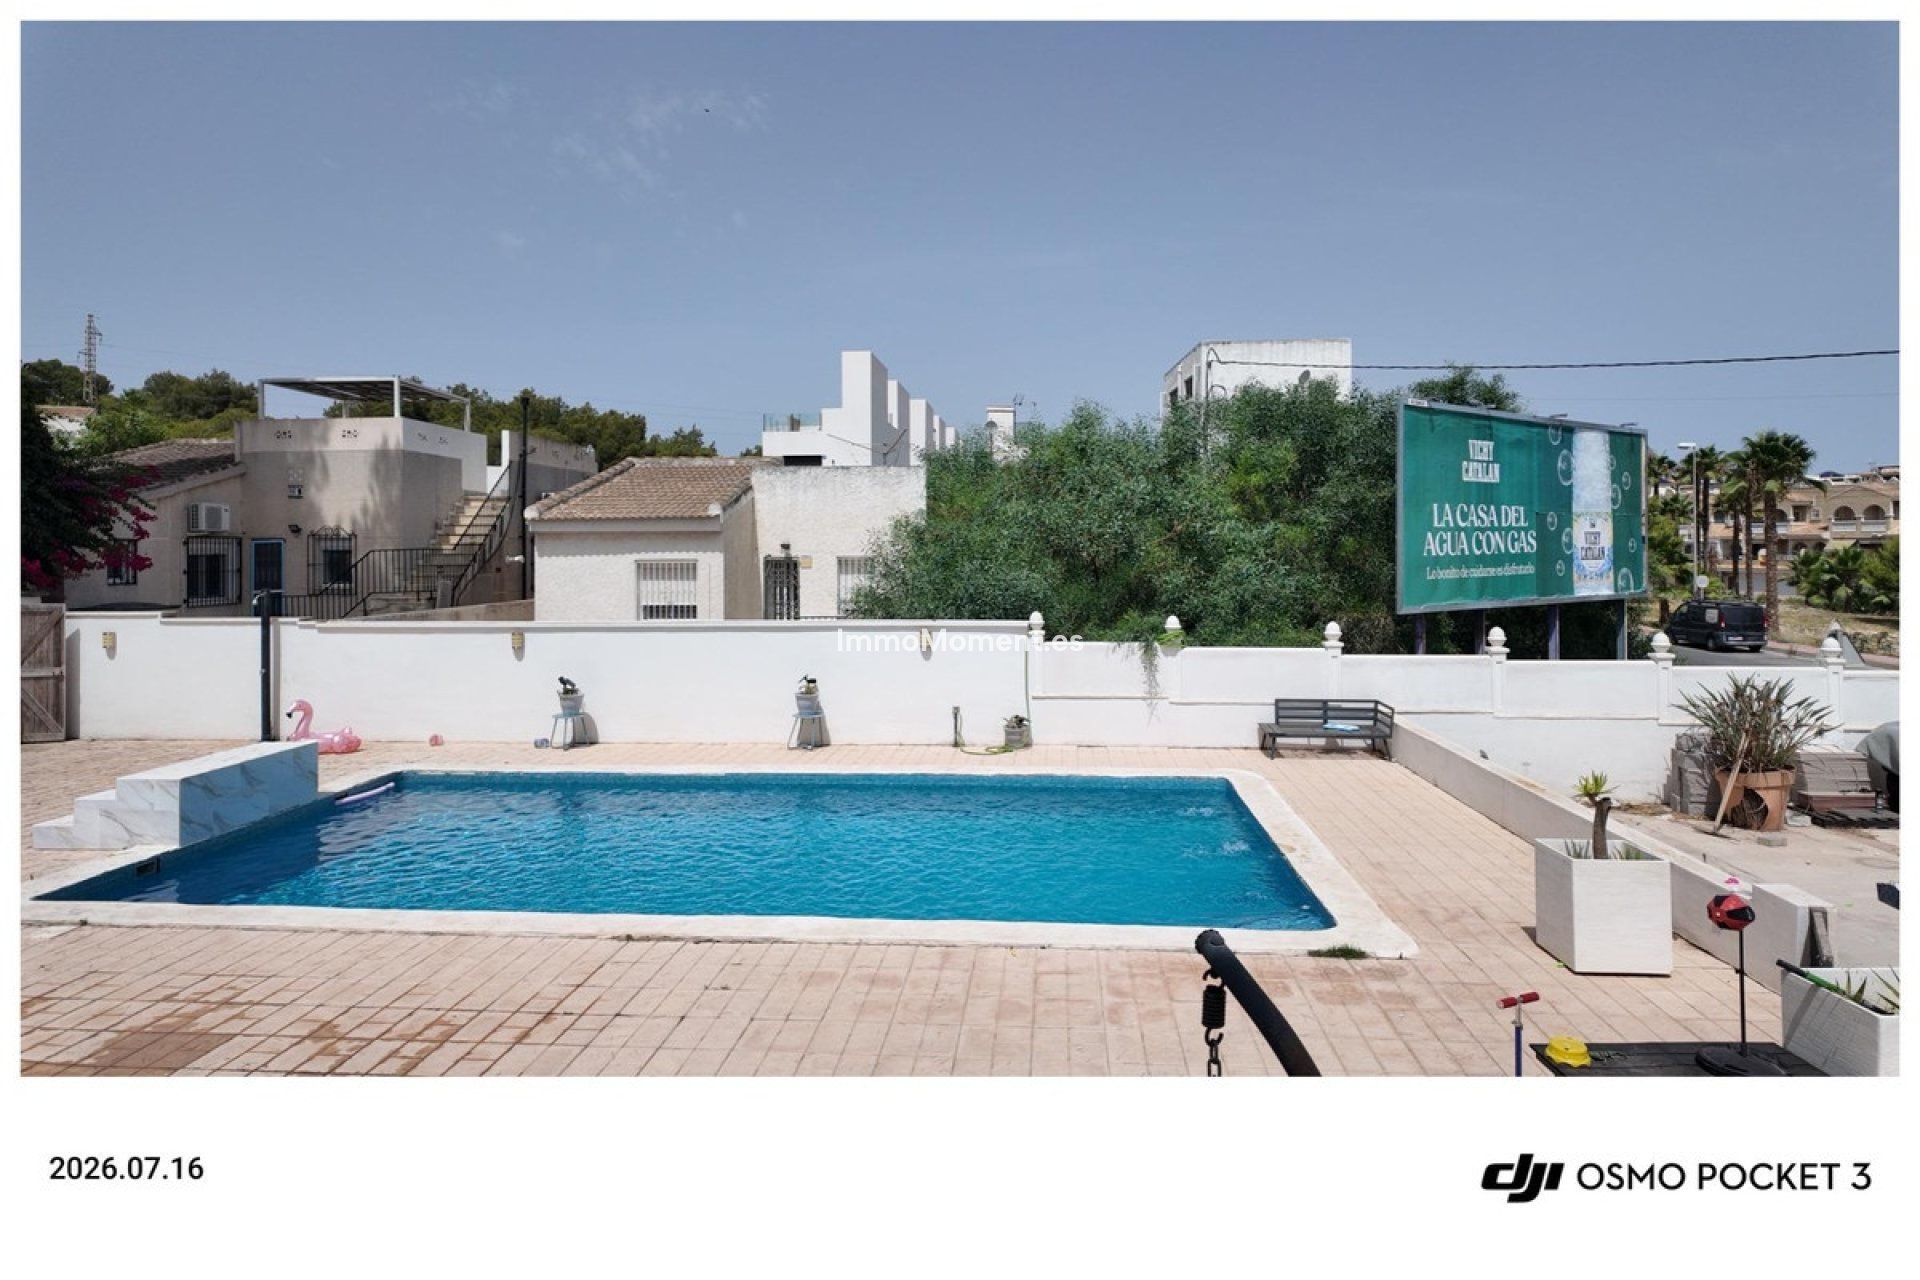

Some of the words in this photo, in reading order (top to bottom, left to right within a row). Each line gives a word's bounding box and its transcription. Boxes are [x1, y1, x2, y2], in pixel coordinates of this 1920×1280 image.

[1433, 503, 1454, 527] LA
[1455, 503, 1499, 527] CASA
[1501, 505, 1528, 527] DEL
[1423, 531, 1469, 556] AGUA
[1471, 531, 1505, 555] CON
[1506, 531, 1537, 553] GAS
